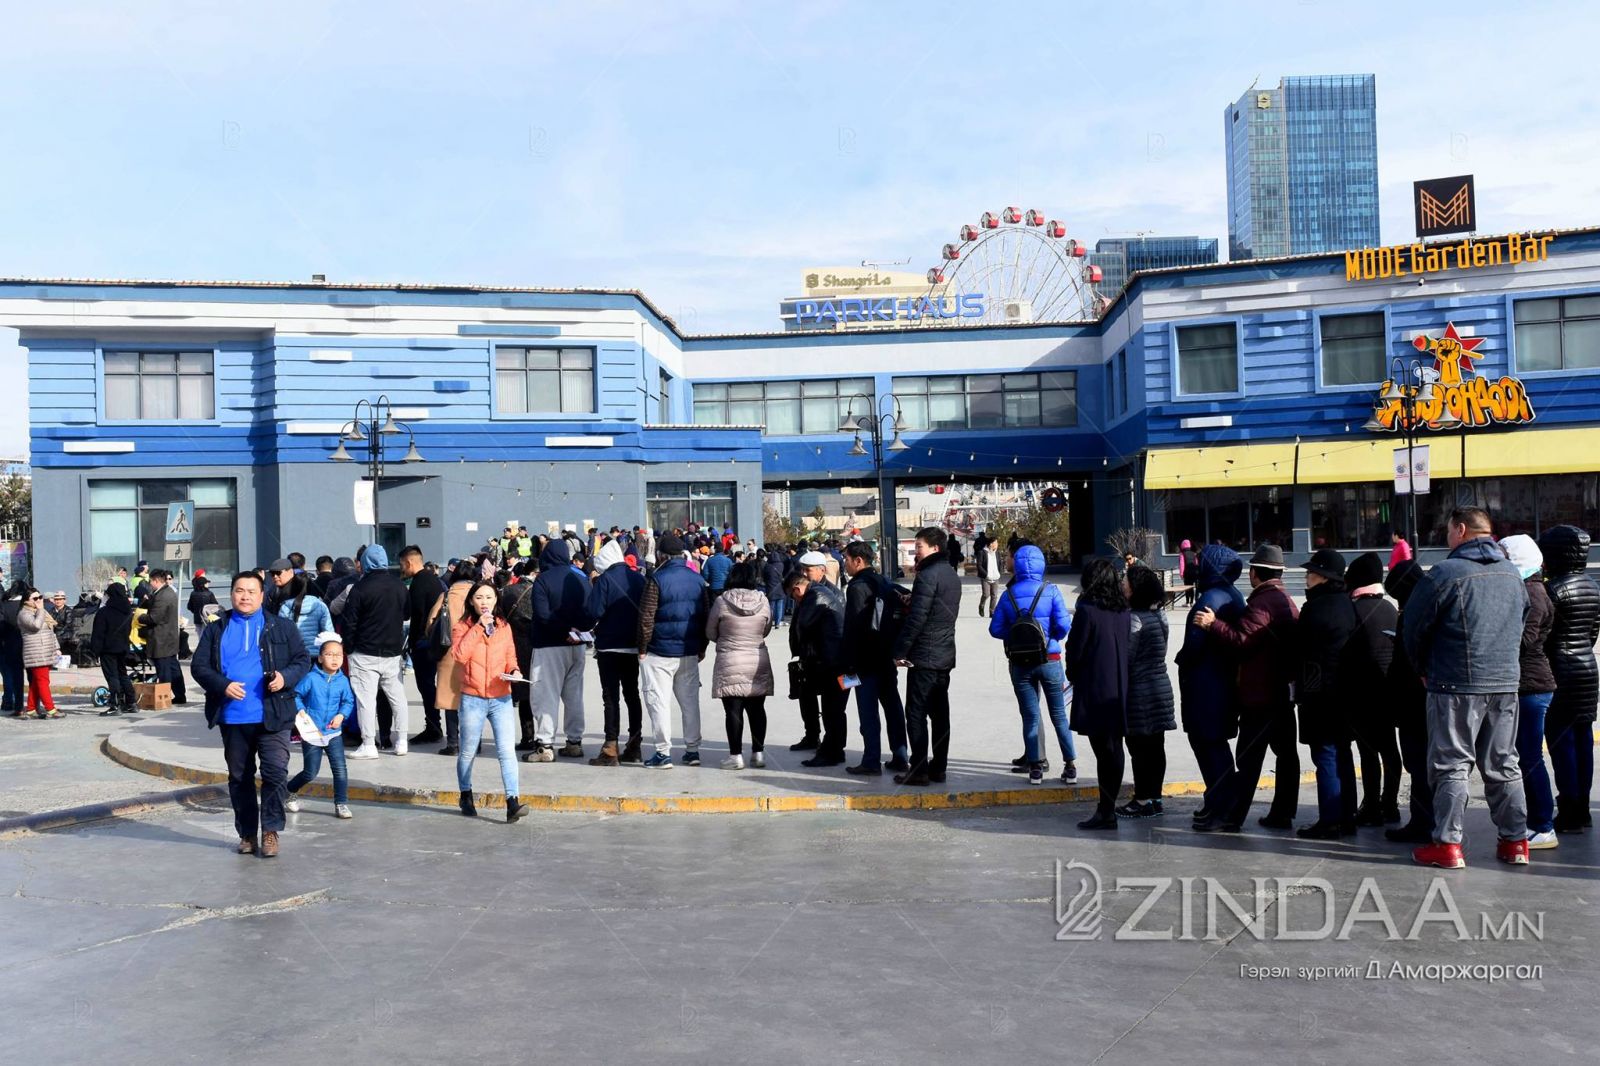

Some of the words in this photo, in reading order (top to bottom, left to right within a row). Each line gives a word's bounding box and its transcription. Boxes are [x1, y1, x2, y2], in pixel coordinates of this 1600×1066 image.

[1345, 246, 1406, 282] MODE
[1410, 239, 1502, 274] Garden
[1507, 232, 1554, 265] Bar
[795, 294, 985, 324] PARKHAUS
